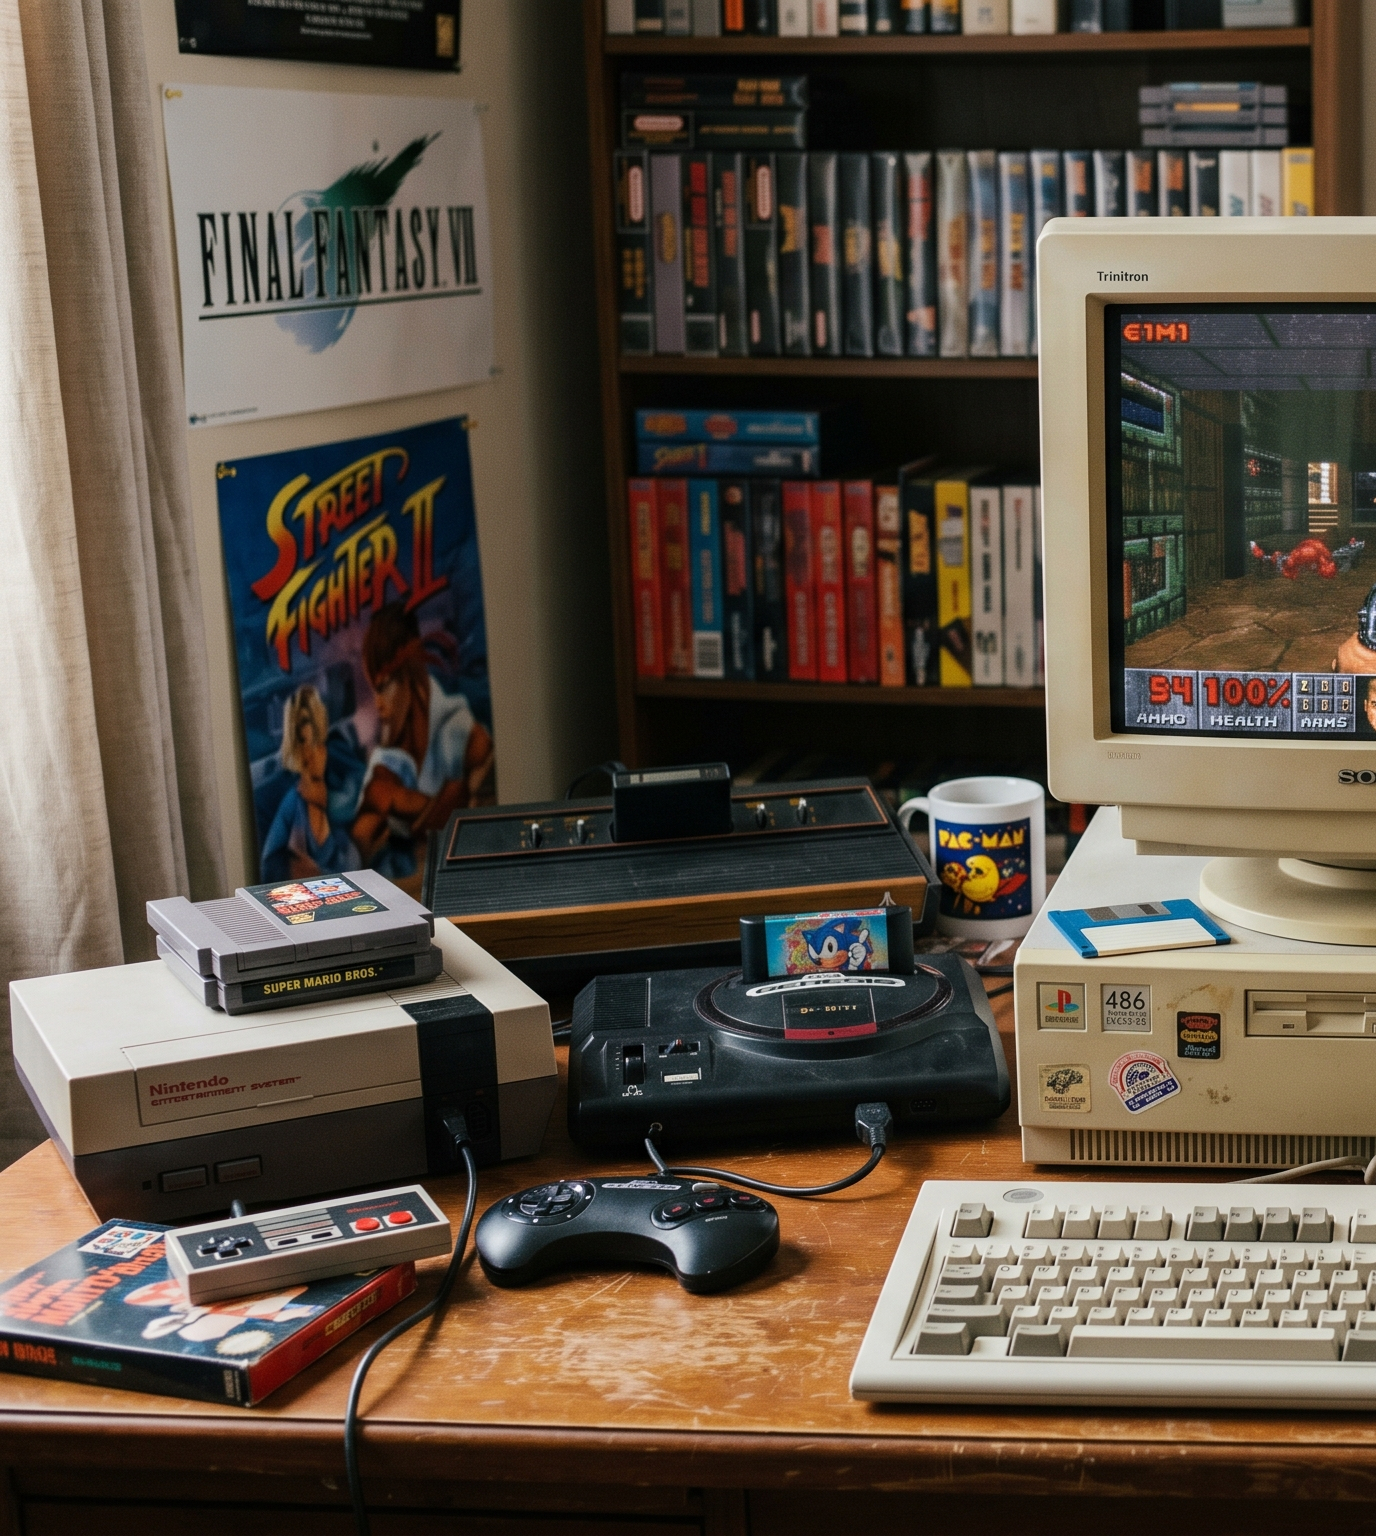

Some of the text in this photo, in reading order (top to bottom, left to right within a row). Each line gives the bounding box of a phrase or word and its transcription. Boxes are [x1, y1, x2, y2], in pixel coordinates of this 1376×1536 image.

[196, 205, 479, 307] FINAL FANTASY VII
[1096, 271, 1149, 282] Trinitron
[251, 447, 409, 600] STREET
[265, 474, 449, 671] FIGHTER II
[1203, 676, 1291, 709] 100%
[1210, 715, 1278, 727] HEALTH
[938, 827, 1025, 850] PAC-MAN
[263, 966, 378, 995] SUPER MARIO BROS.
[1105, 990, 1146, 1010] 486
[150, 1075, 229, 1097] Nintendo
